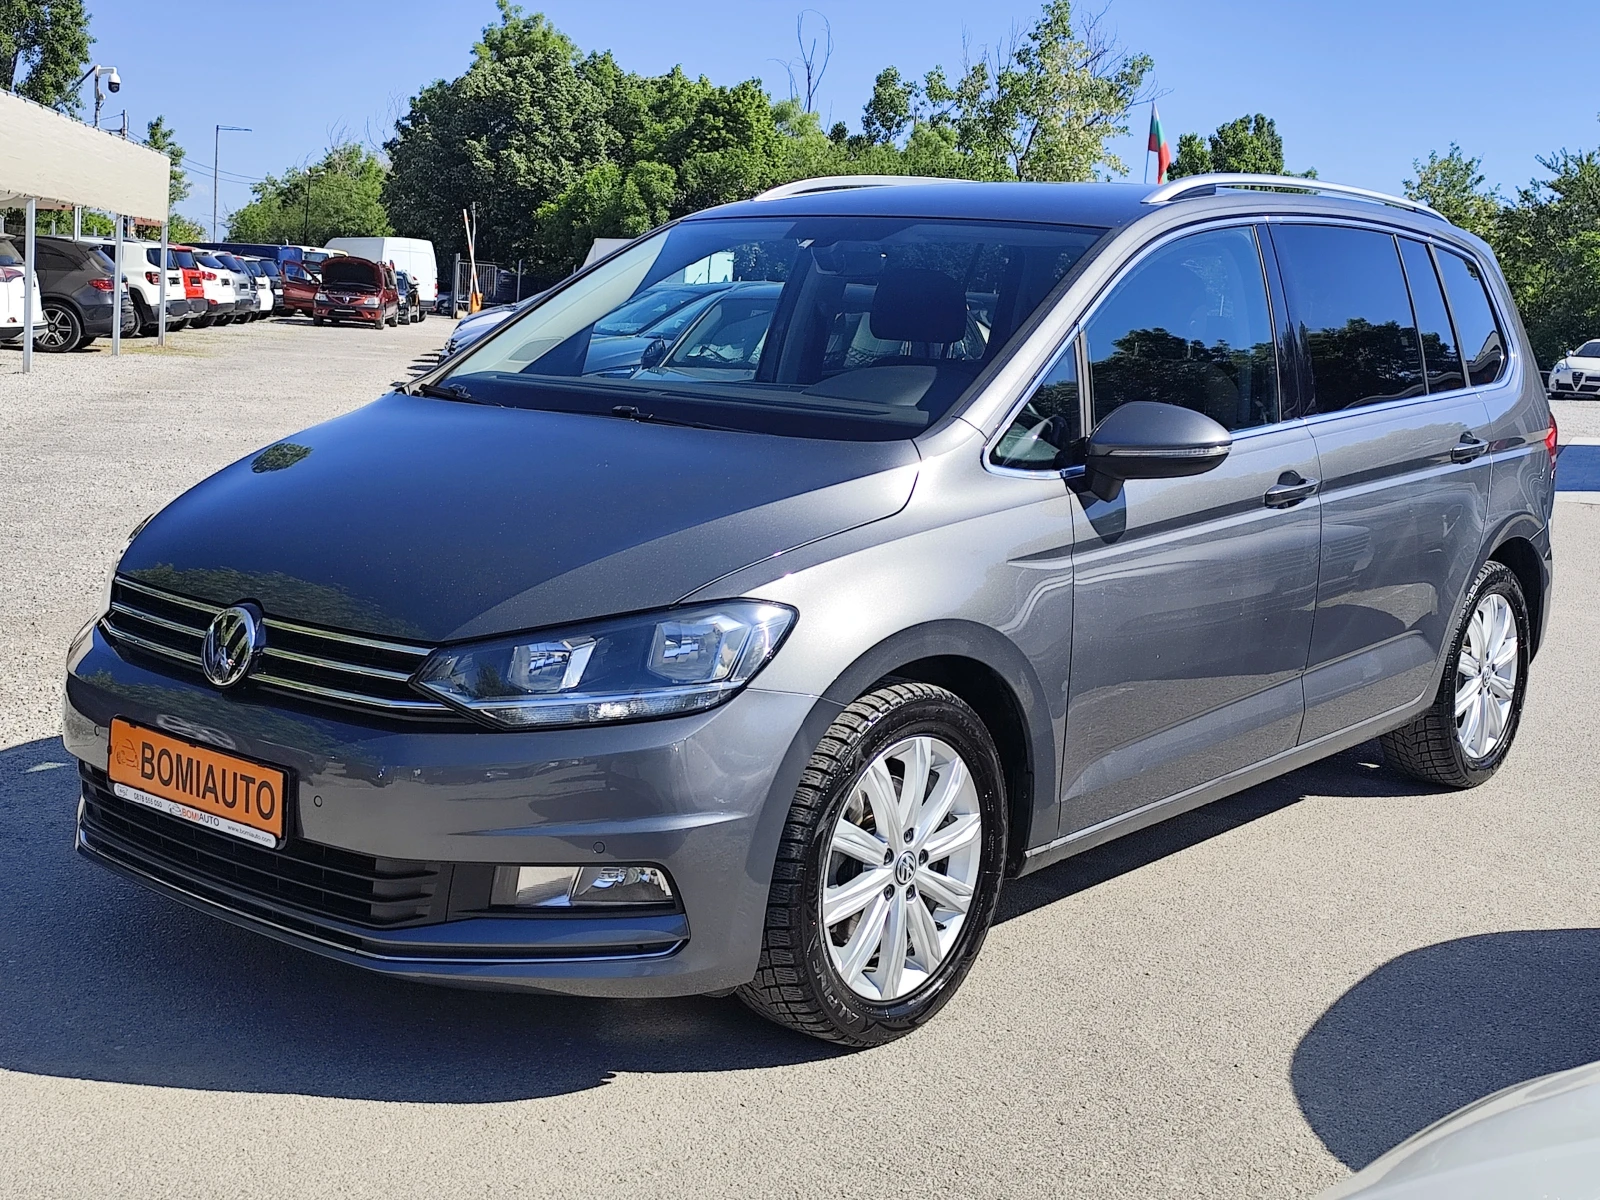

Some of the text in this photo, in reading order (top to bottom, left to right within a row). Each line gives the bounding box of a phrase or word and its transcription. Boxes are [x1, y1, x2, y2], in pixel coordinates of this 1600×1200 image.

[141, 741, 276, 820] BOMIAUTO
[181, 808, 220, 827] BOMIAUTO
[227, 825, 272, 844] www.bomiauto.com
